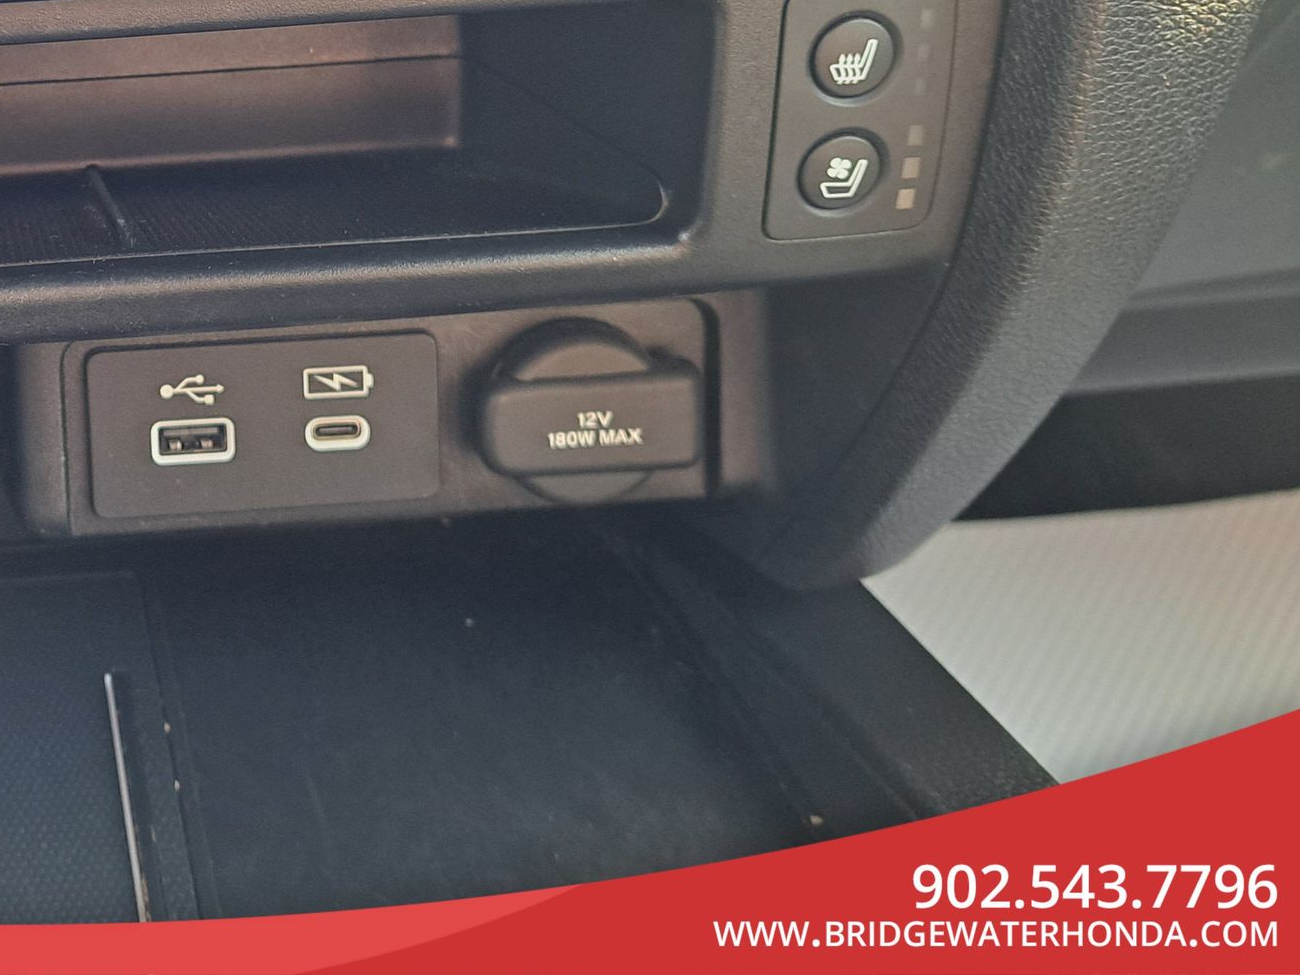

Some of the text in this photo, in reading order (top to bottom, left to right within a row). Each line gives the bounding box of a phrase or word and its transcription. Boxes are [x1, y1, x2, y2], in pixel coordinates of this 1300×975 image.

[577, 411, 612, 428] 12V
[547, 428, 643, 448] 180W MAX
